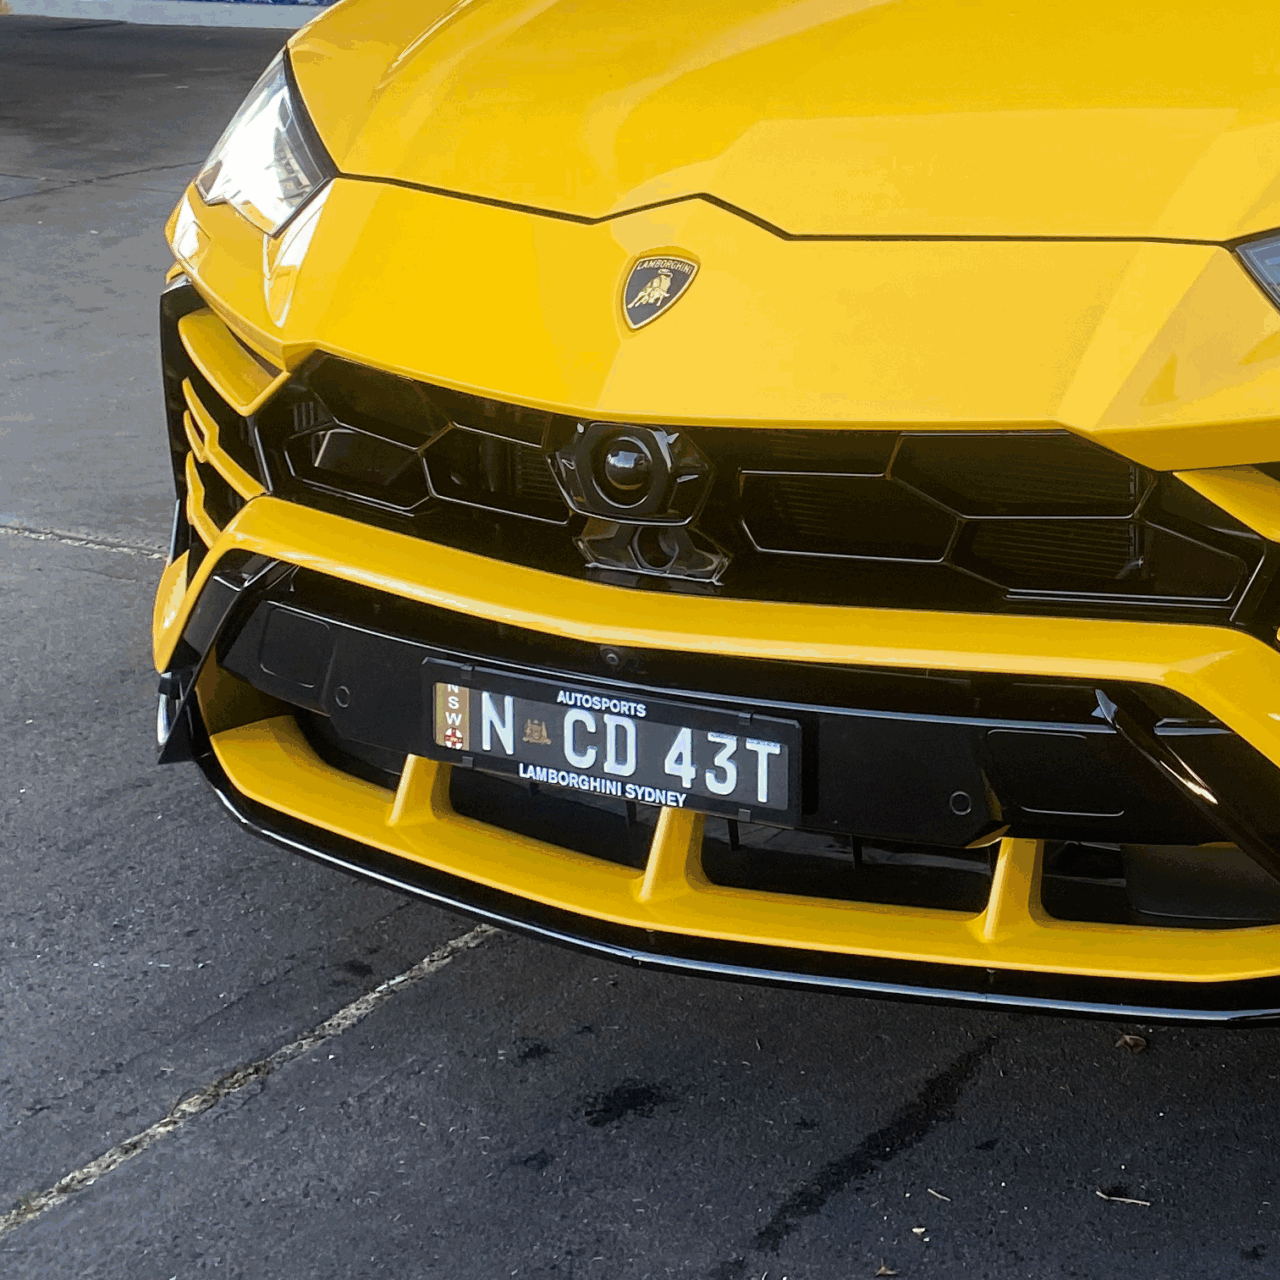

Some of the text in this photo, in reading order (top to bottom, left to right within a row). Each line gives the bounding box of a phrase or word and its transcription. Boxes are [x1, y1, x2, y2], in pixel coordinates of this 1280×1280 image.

[636, 259, 694, 275] LAMBORGHINI
[556, 690, 647, 718] AUTOSPORTS
[482, 691, 781, 803] N CD 43T
[519, 763, 687, 807] LAMBORGHINI SYDNEY
